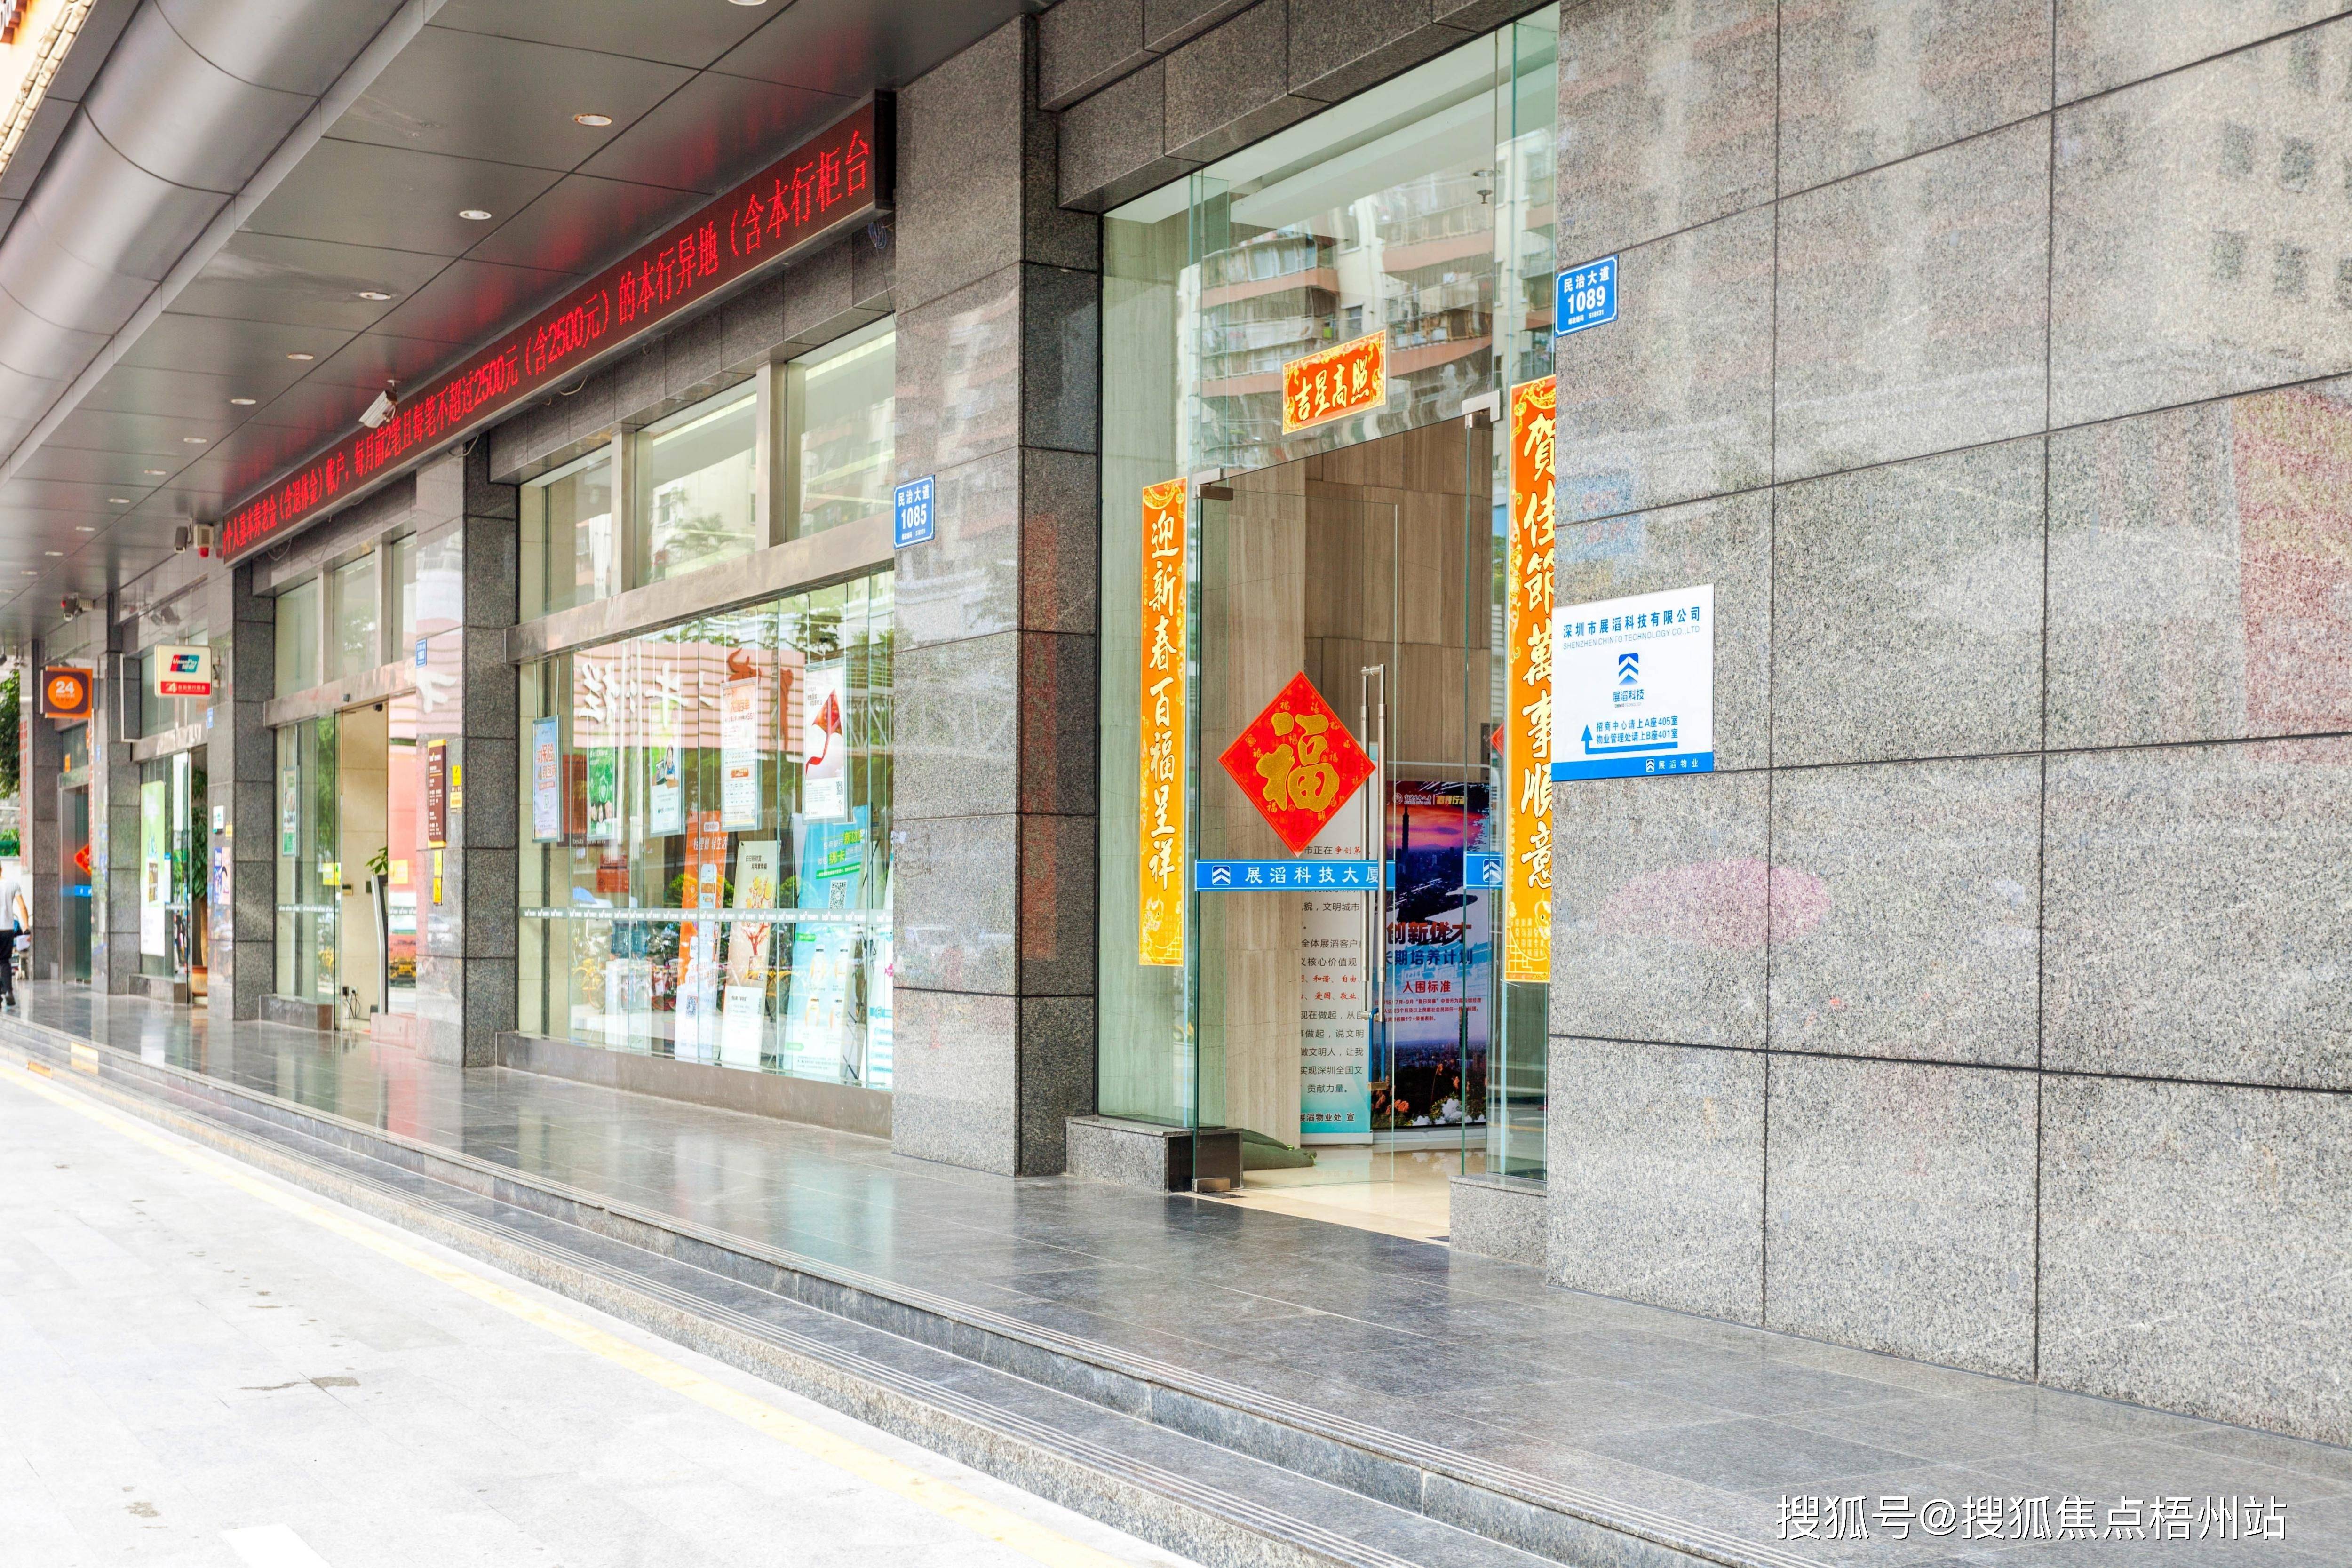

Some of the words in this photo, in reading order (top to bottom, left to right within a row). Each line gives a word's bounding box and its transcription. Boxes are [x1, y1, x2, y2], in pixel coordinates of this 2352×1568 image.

[1564, 265, 1609, 294] 民治大道
[1568, 286, 1605, 314] 1089
[1295, 355, 1370, 421] 吉星高照
[898, 484, 930, 507] 民治大道
[901, 503, 927, 530] 1085
[1563, 606, 1700, 638] 深圳市展滔科技有限公司
[1564, 639, 1597, 650] SHENZHEN
[1598, 635, 1623, 645] CHINTO
[1625, 629, 1671, 642] TECHNOLOGY
[56, 680, 75, 694] 24
[1613, 689, 1644, 702] 展滔科技
[1148, 510, 1178, 891] 迎新春百福呈祥
[1597, 715, 1678, 732] 招商中心请上A座405室
[1597, 729, 1678, 744] 物业管理处请上B座401室
[1256, 711, 1340, 812] 福
[1659, 758, 1699, 770] 展滔物业
[1304, 845, 1370, 855] 市正在争创第
[1245, 866, 1378, 884] 展滔科技大厦
[1387, 922, 1471, 945] 创新优才
[1302, 939, 1361, 948] 全体展滔客户
[1403, 981, 1451, 994] 入围标准
[1301, 1066, 1362, 1075] 实现深圳全国文
[1307, 1084, 1347, 1093] 贡献力量。
[1346, 1113, 1355, 1122] 宣
